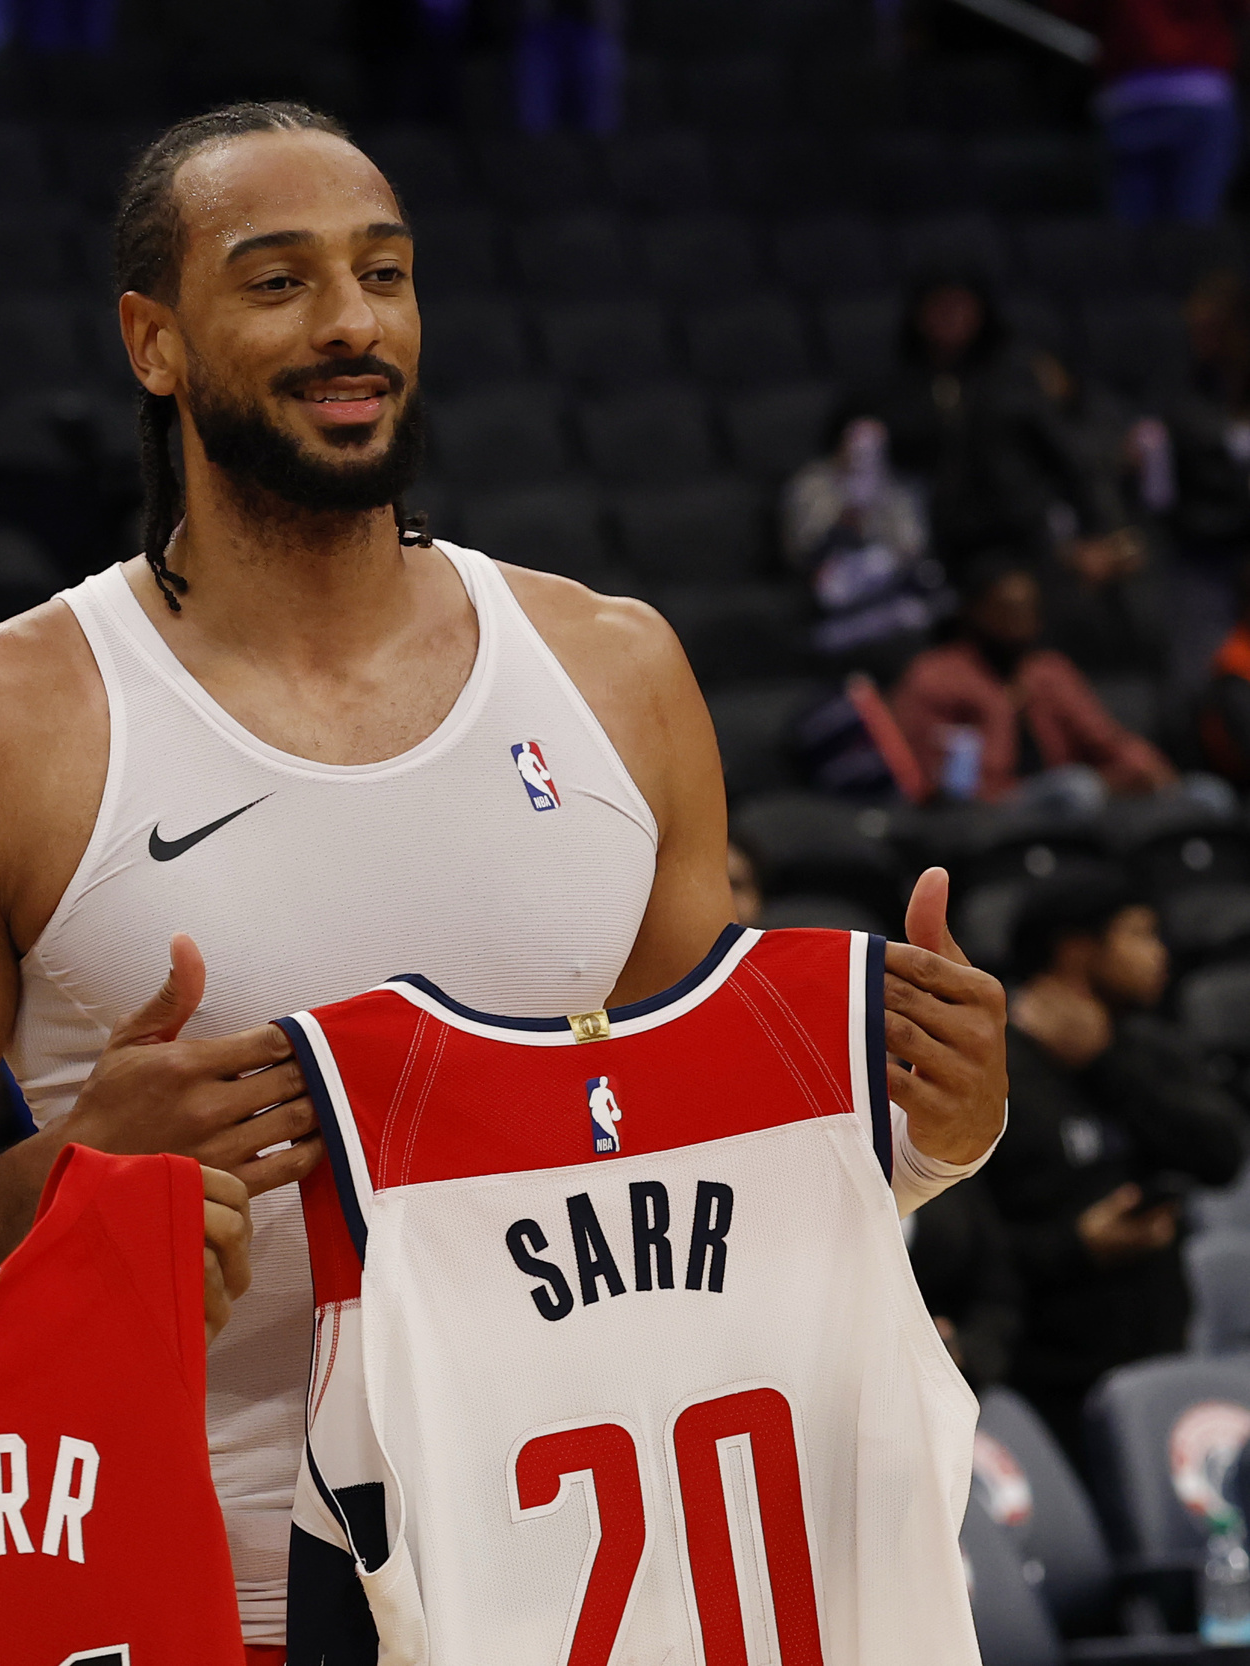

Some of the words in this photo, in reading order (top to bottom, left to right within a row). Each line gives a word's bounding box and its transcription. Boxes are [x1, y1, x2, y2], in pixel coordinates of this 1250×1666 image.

[533, 795, 551, 809] NBA
[596, 1137, 613, 1152] NBA
[506, 1180, 733, 1321] SARR
[512, 1385, 825, 1666] 20
